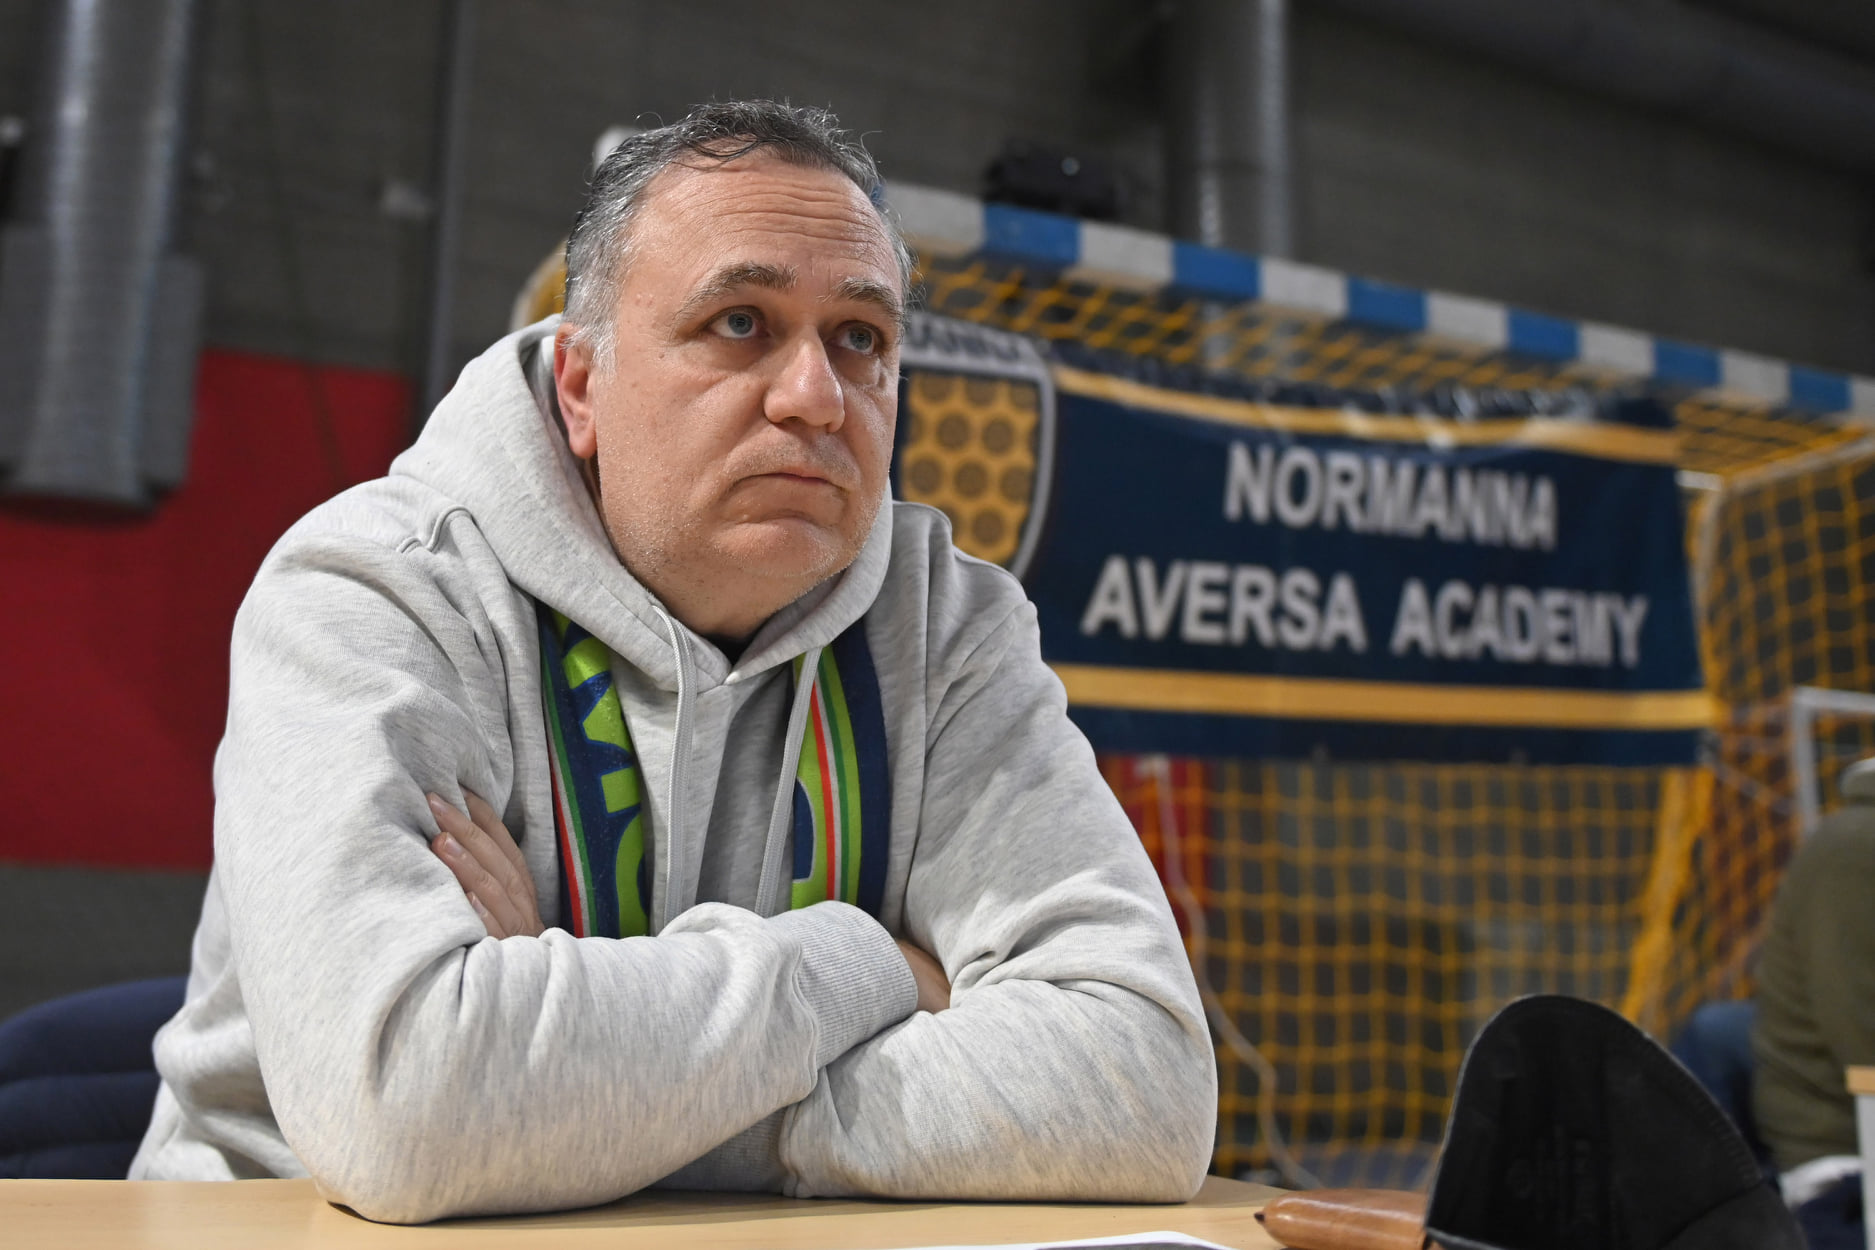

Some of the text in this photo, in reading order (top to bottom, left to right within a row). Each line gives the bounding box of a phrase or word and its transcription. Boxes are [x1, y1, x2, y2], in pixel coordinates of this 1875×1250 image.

[1225, 442, 1556, 550] NORMANNA
[1081, 554, 1648, 668] AVERSA ACADEMY
